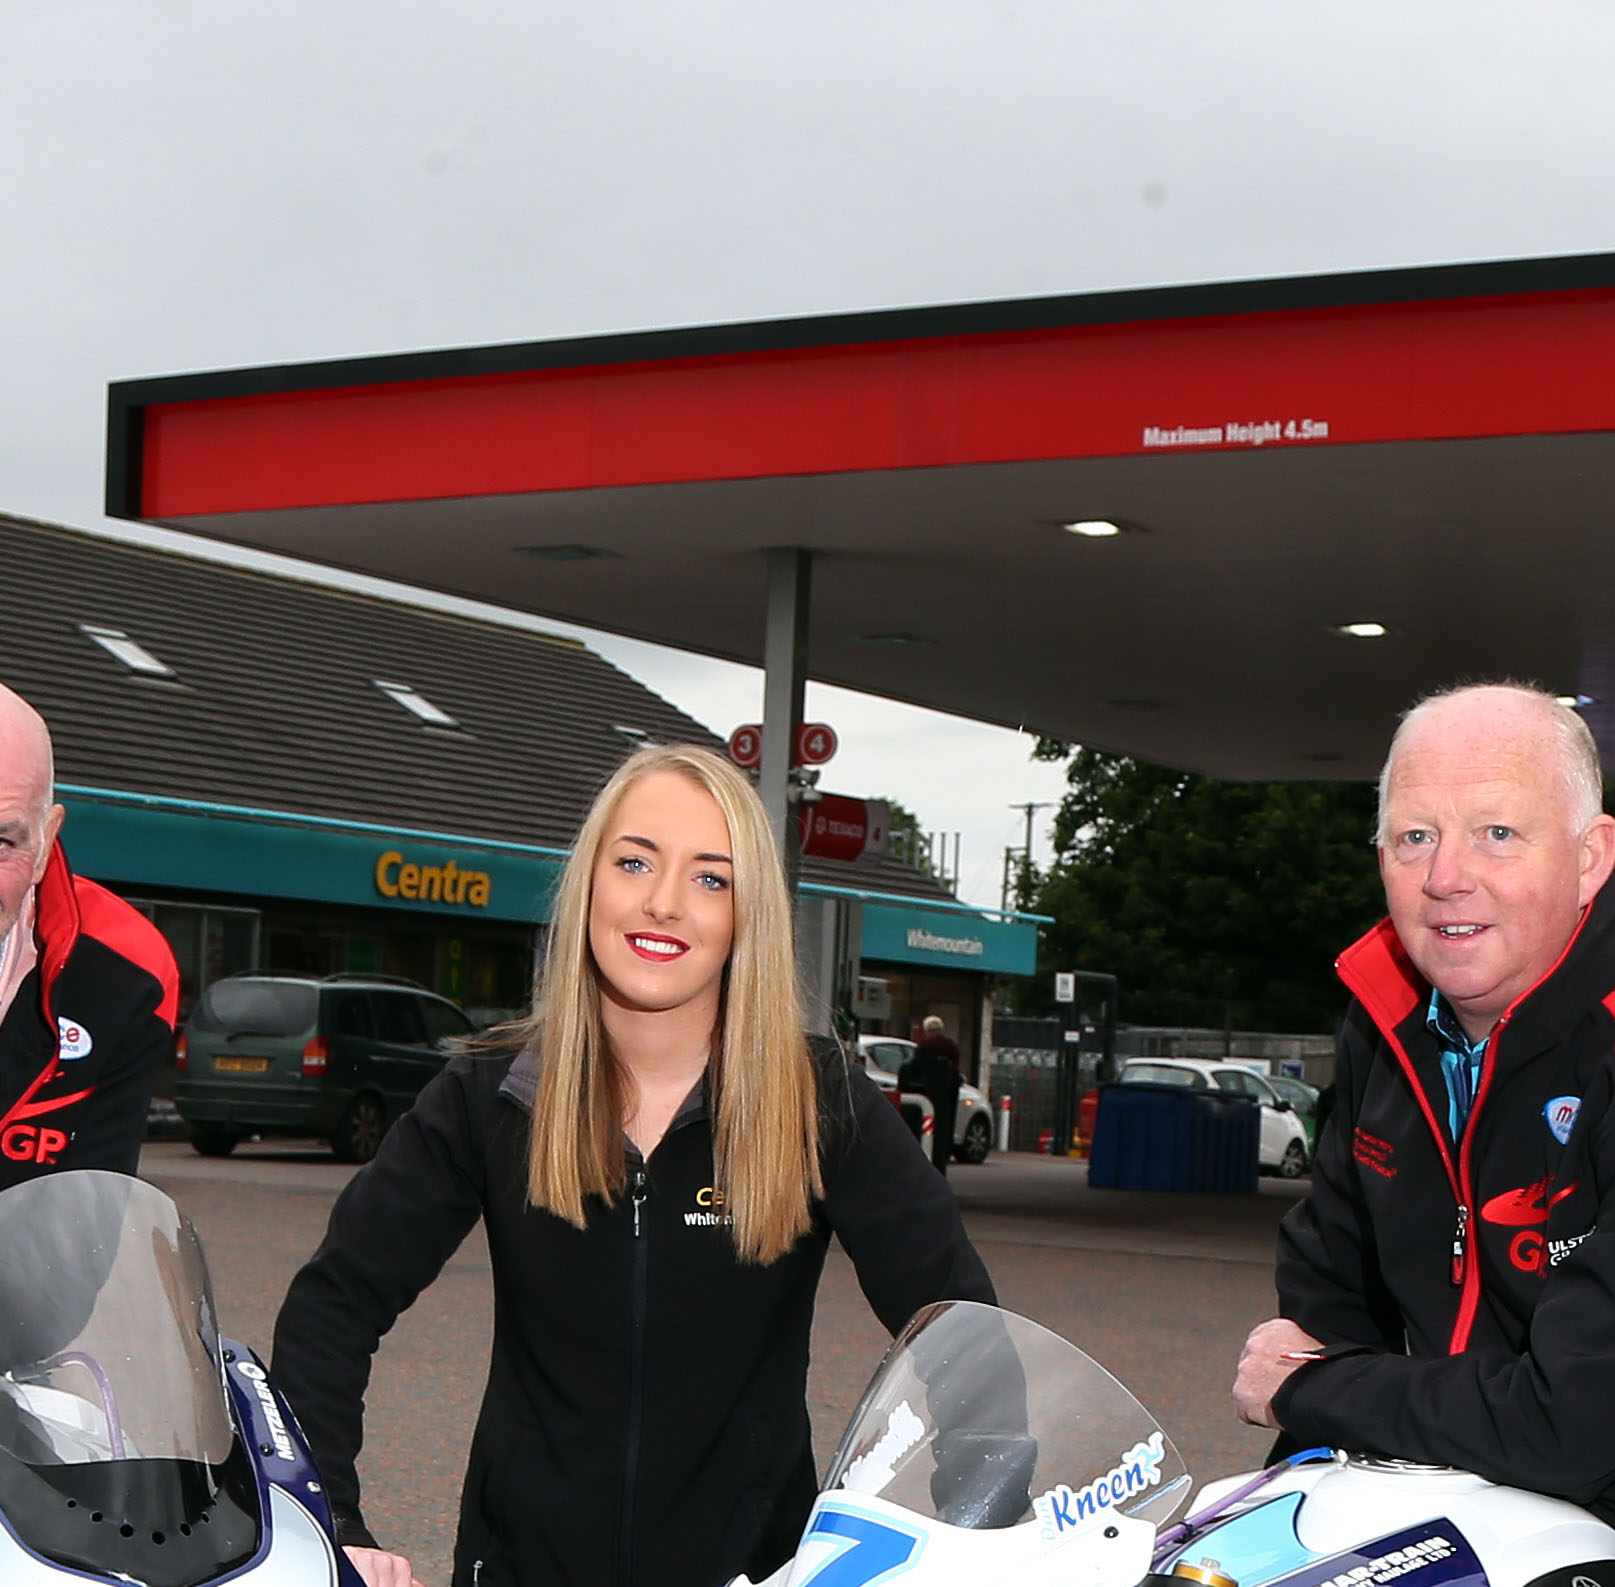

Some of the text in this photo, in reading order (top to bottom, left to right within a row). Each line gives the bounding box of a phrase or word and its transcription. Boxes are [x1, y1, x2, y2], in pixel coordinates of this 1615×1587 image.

[1143, 418, 1329, 447] Maximum Height 4.5m
[738, 735, 754, 755] 3
[809, 733, 826, 754] 4
[376, 851, 491, 907] Centra
[906, 928, 984, 956] Whitemountain
[1, 1125, 68, 1164] GP
[252, 1379, 296, 1461] METZELER
[1050, 1461, 1146, 1533] Kneen
[1429, 1547, 1453, 1567] LTD
